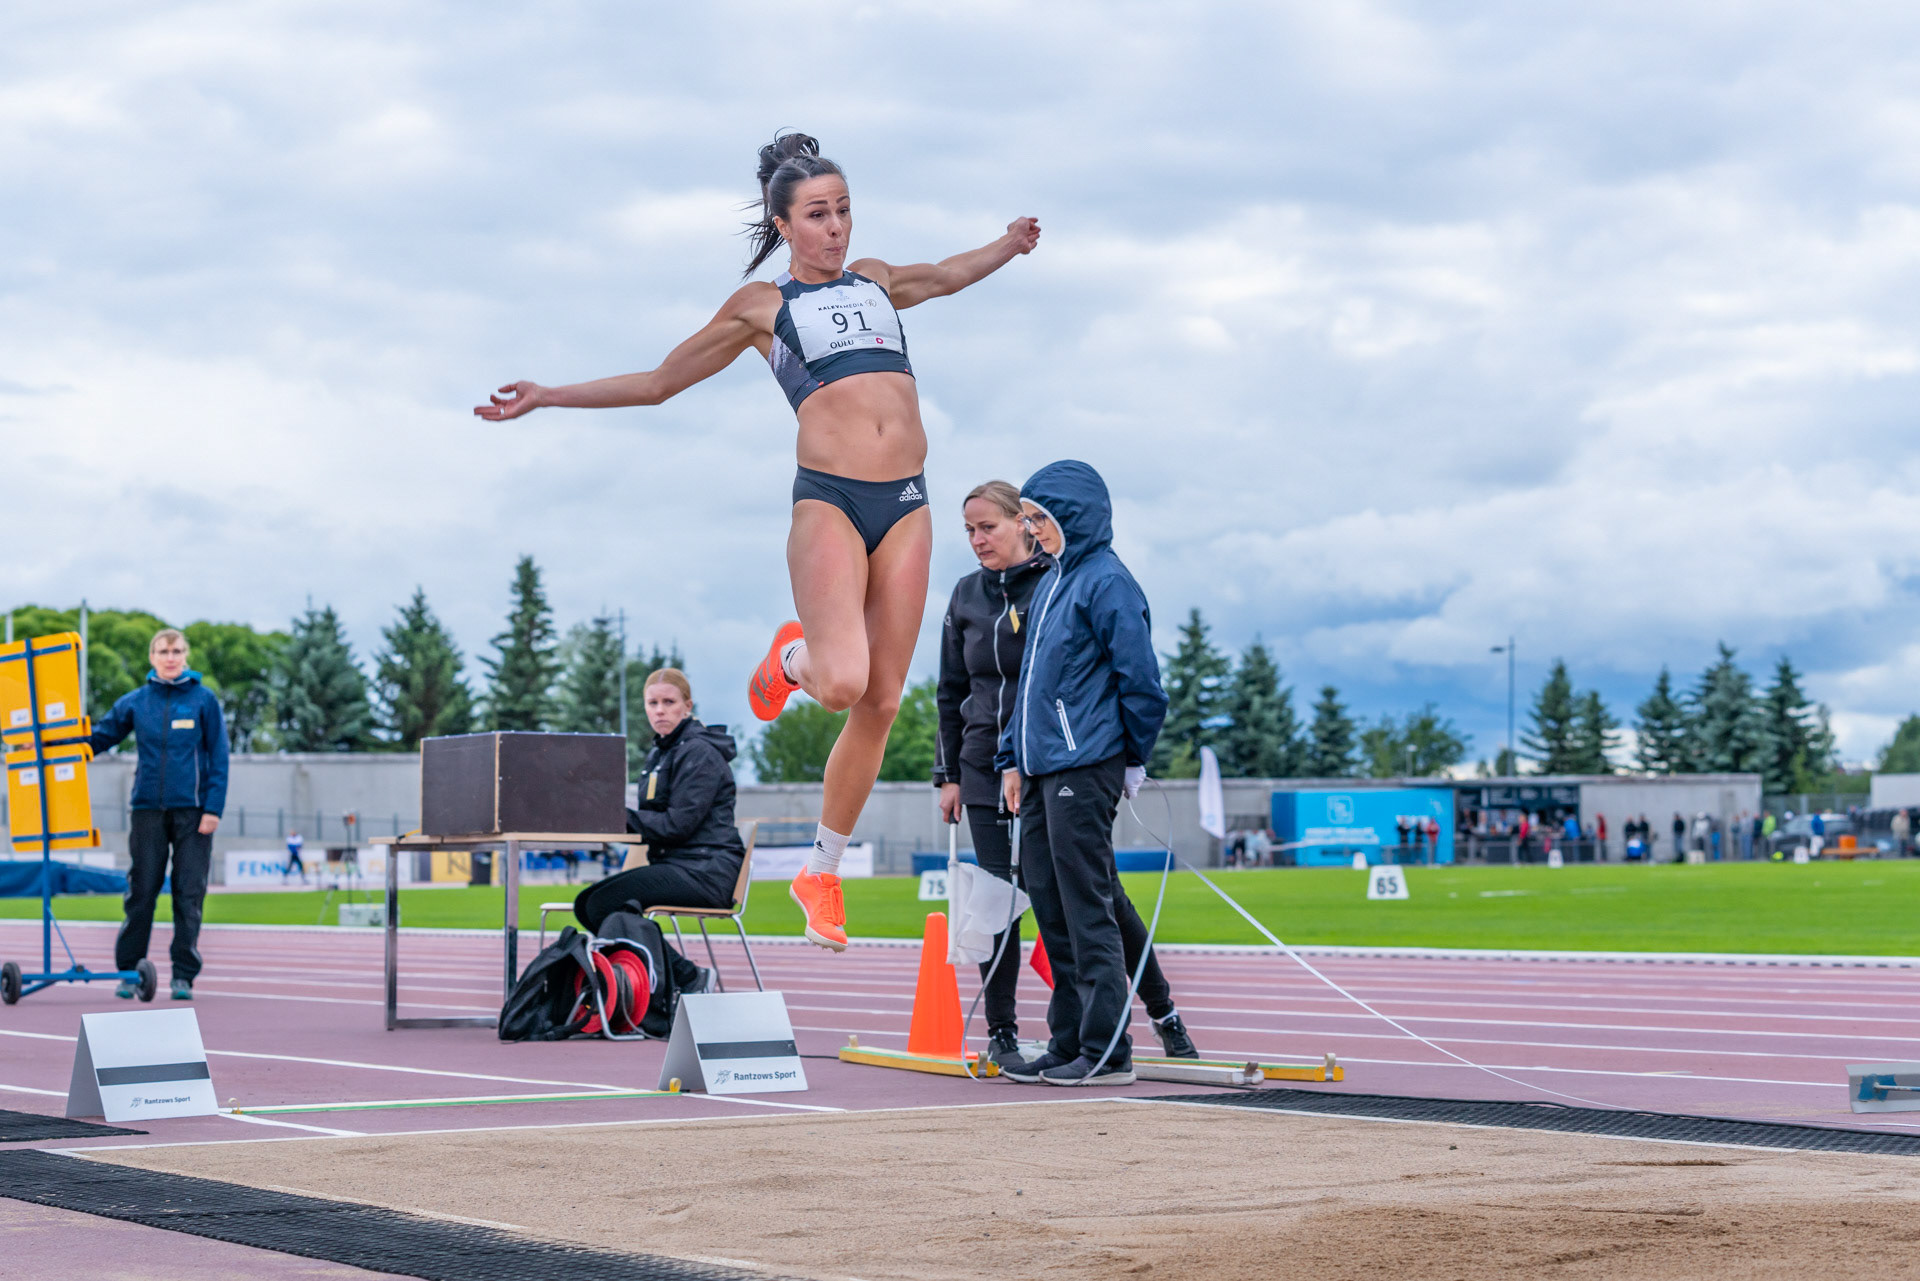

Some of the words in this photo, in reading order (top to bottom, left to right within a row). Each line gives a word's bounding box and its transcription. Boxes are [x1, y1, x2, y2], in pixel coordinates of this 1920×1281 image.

[831, 310, 872, 334] 91
[830, 339, 855, 349] OULU
[899, 493, 923, 502] adidas
[927, 879, 946, 896] 75
[1376, 876, 1398, 895] 65
[734, 1072, 773, 1081] Rantzows
[774, 1070, 796, 1080] Sport
